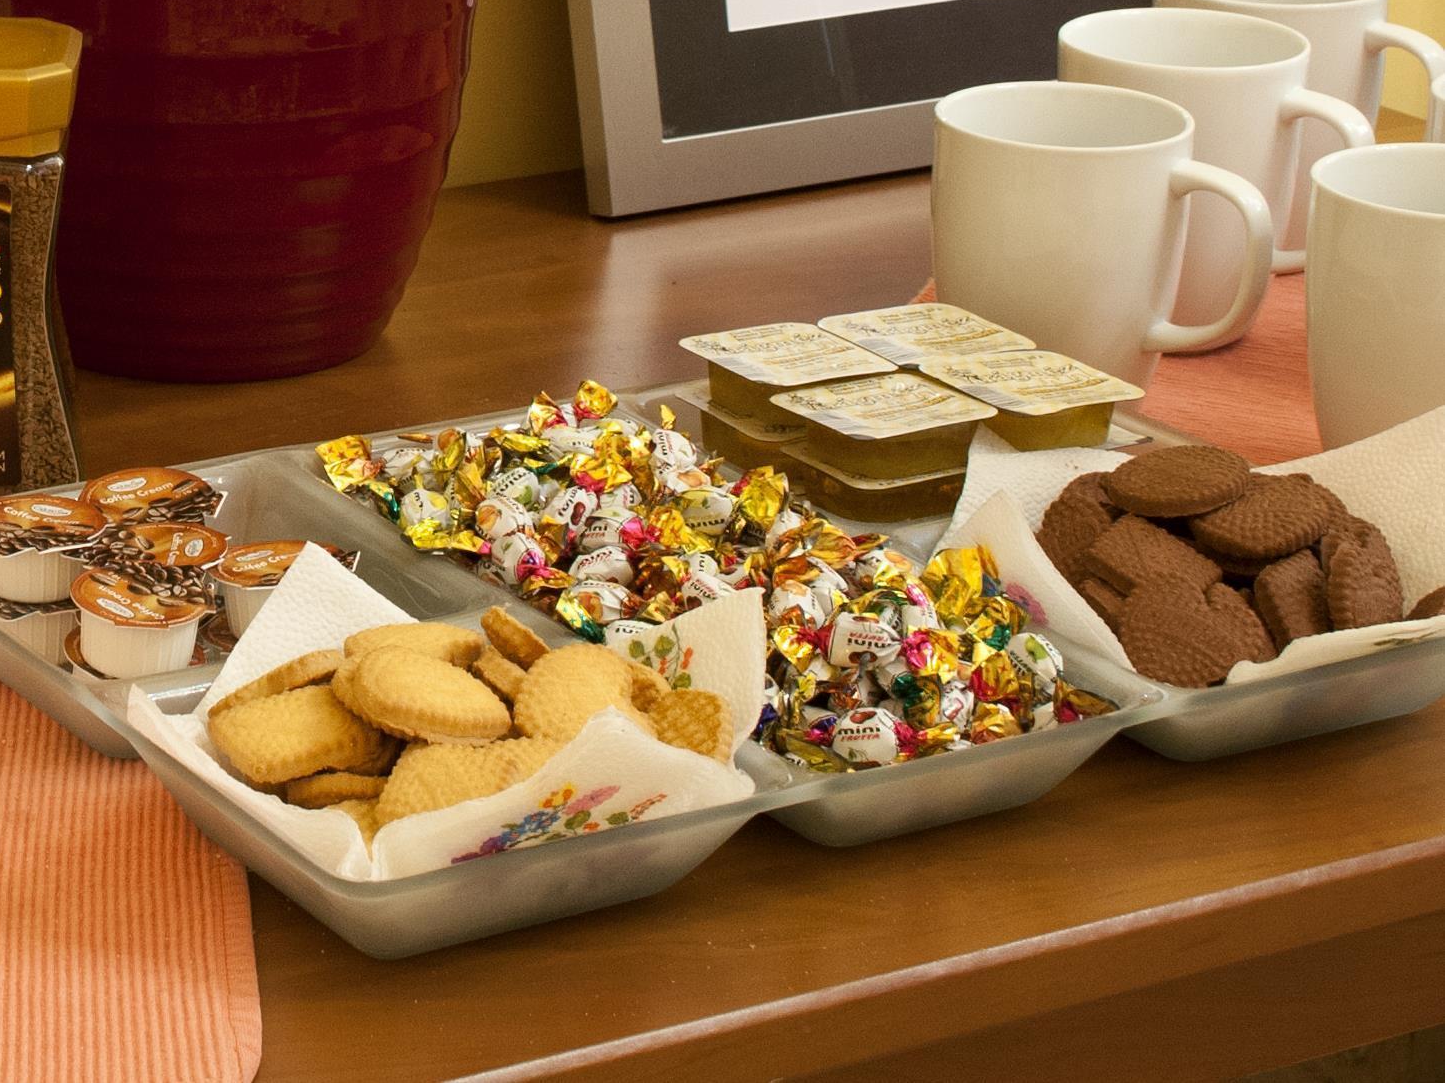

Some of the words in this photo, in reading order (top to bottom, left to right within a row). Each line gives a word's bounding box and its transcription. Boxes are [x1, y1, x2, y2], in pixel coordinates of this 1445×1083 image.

[99, 493, 136, 505] Coffee
[137, 482, 174, 497] Cream
[837, 724, 881, 735] mini
